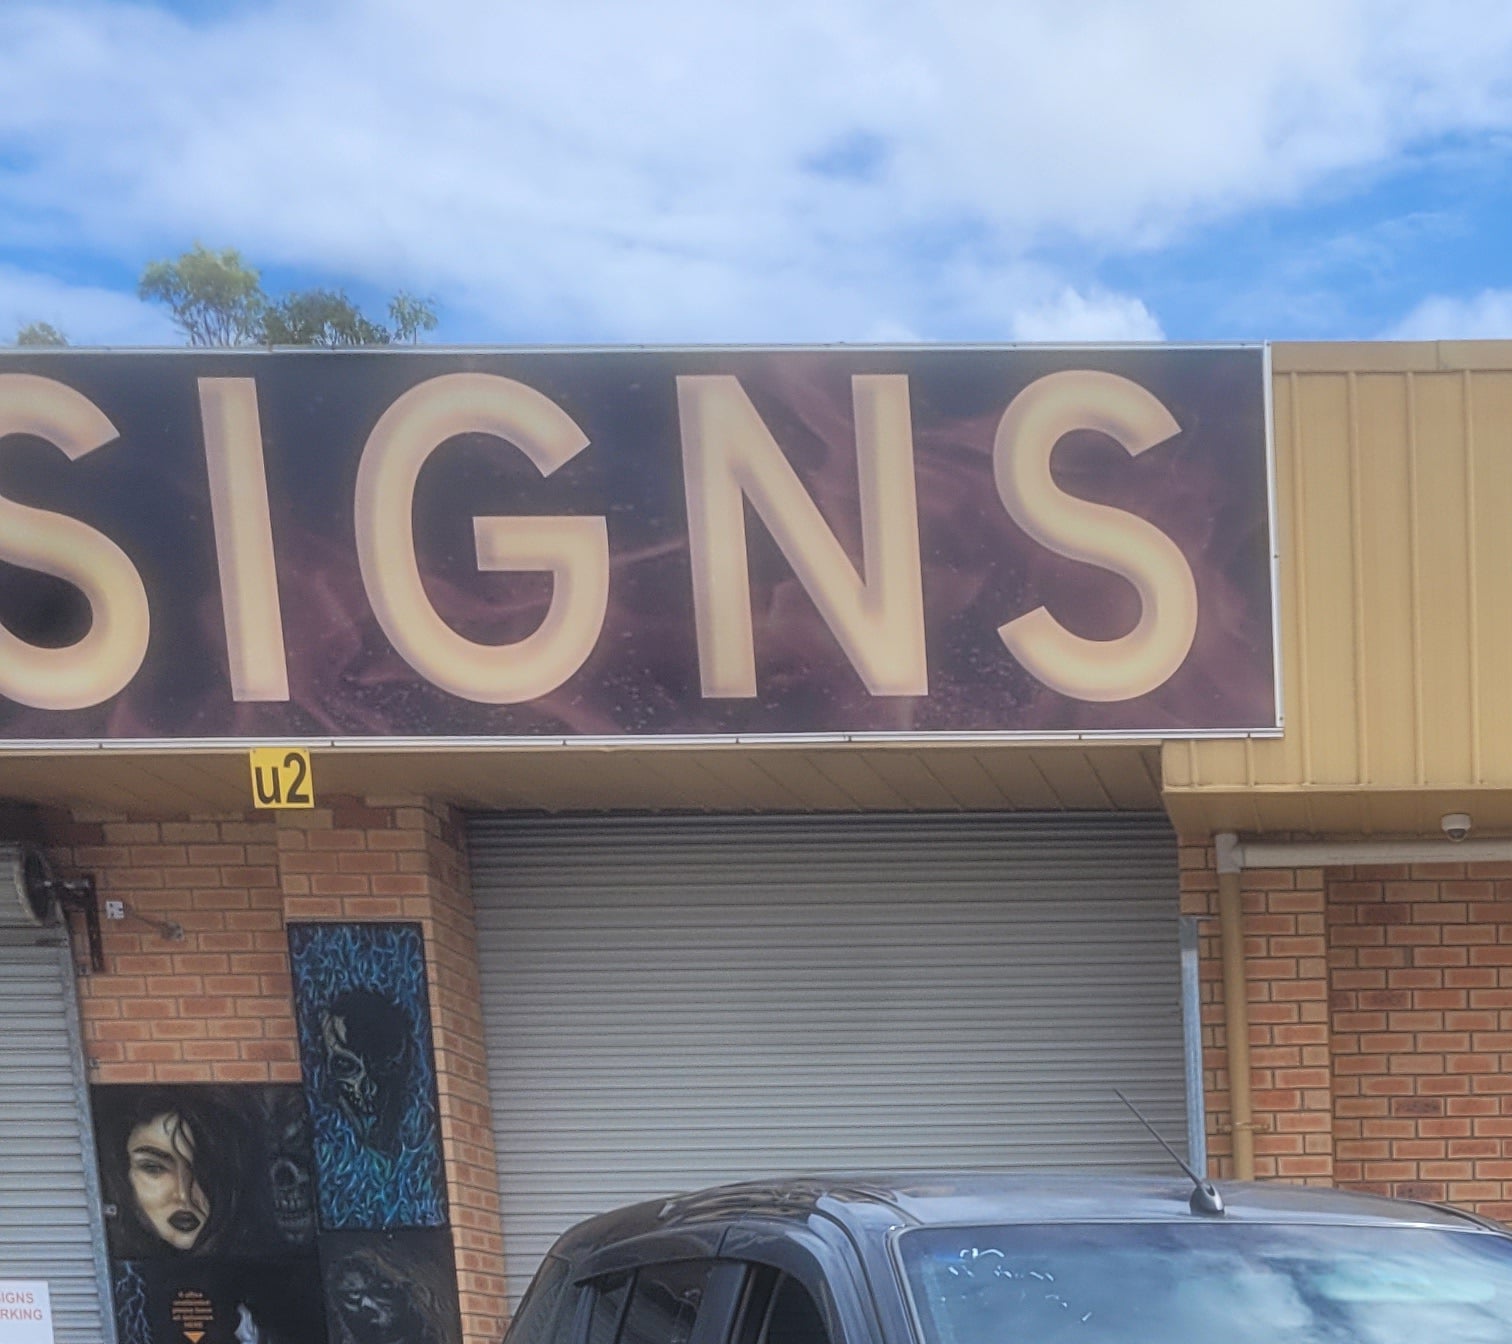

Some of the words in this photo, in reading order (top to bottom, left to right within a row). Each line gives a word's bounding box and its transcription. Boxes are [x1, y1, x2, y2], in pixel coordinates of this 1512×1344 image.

[0, 370, 1199, 710] SIGNS
[254, 752, 310, 804] u2
[0, 1292, 34, 1304] IGNS
